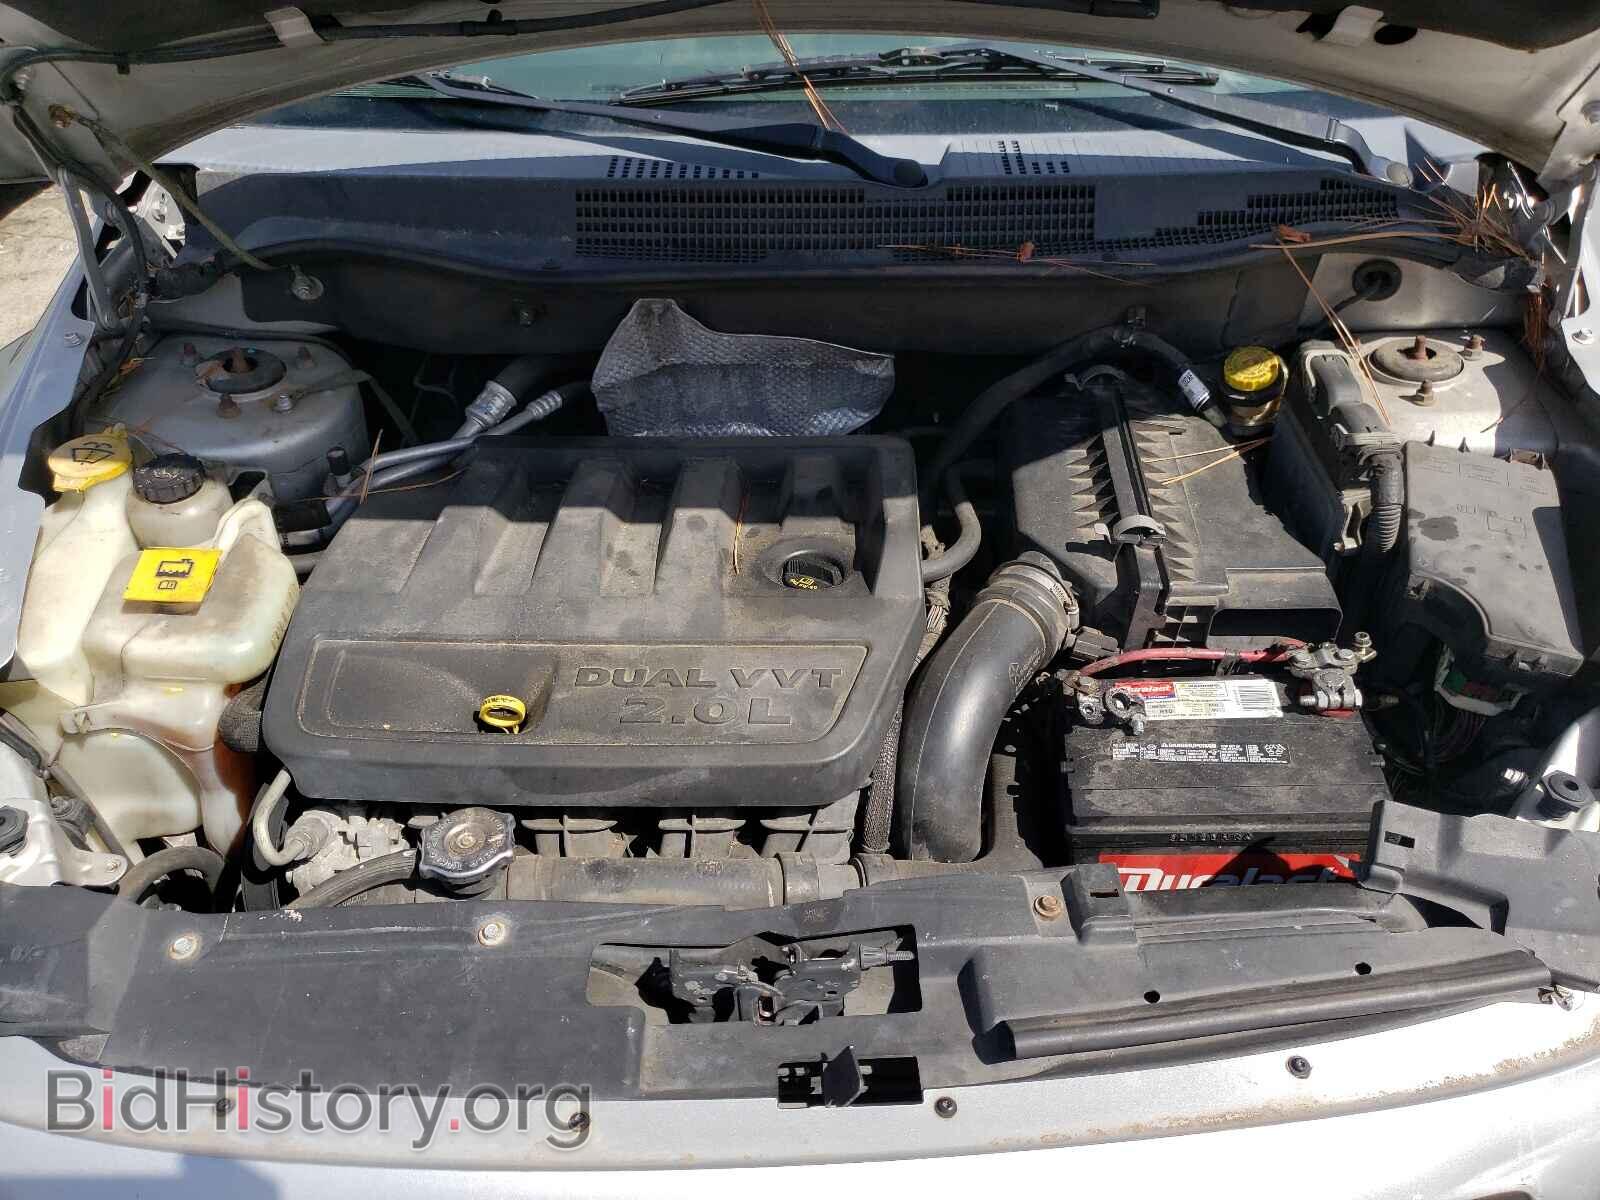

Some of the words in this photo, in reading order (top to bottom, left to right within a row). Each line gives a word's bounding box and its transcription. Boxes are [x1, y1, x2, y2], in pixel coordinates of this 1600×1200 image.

[575, 667, 717, 688] DUAL
[729, 667, 842, 689] VVT
[619, 697, 792, 725] 2.0L
